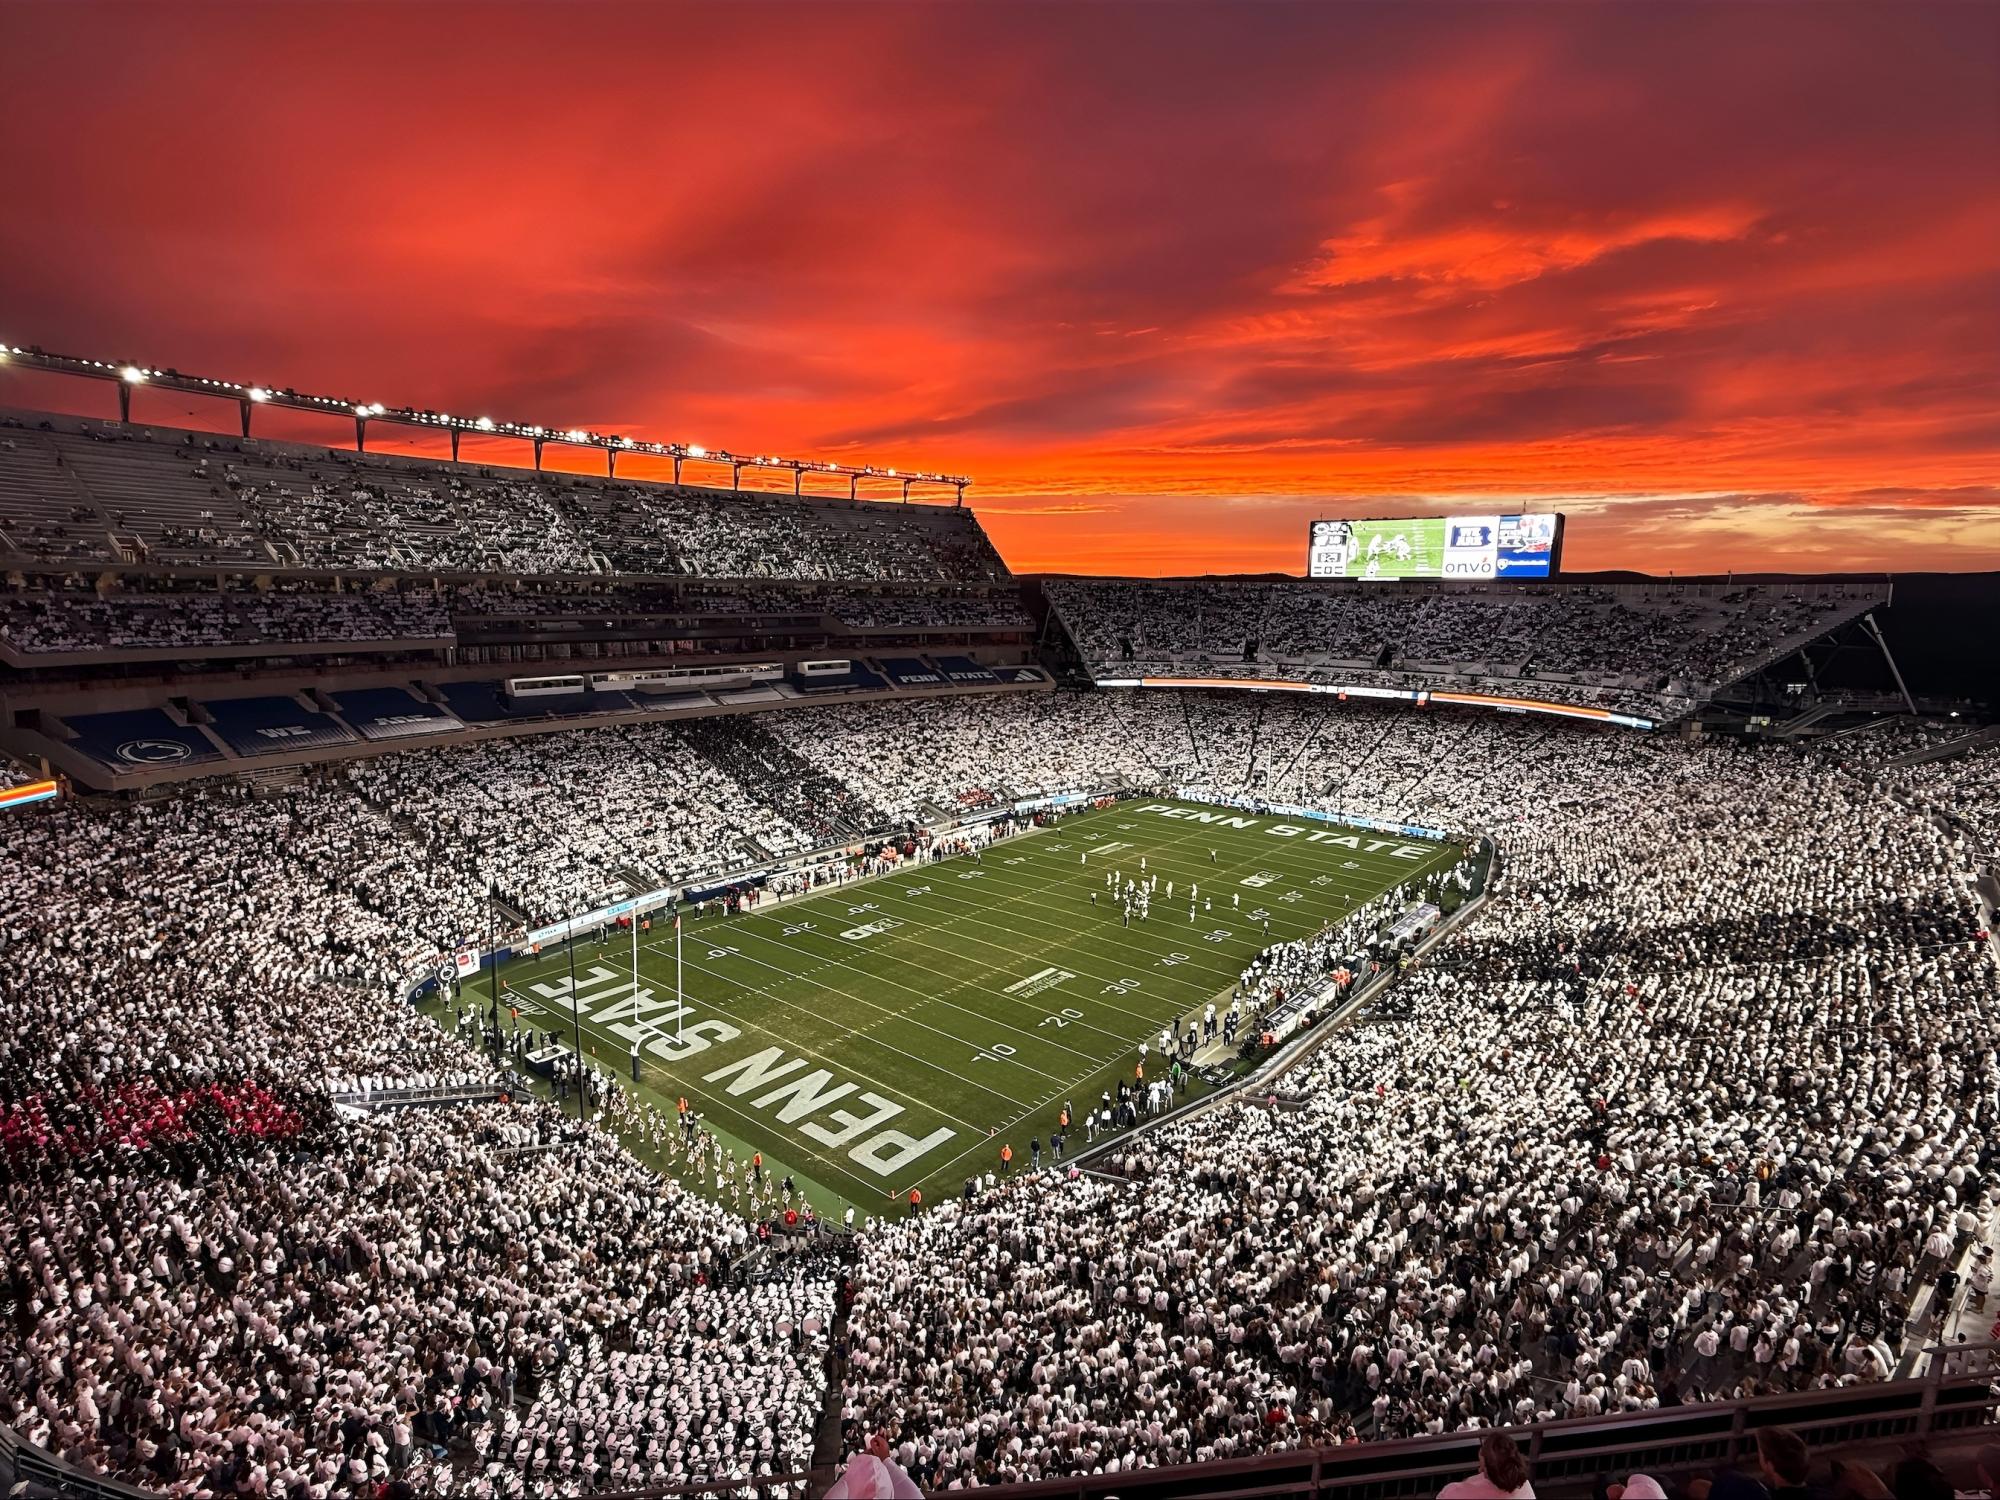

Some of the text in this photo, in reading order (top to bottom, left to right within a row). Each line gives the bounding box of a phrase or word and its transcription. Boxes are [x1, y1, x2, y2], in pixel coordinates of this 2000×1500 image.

[898, 671, 993, 683] PENN STATE
[256, 725, 312, 738] WE
[1134, 804, 1432, 860] PENN STATE
[1245, 908, 1270, 920] 40
[784, 921, 817, 935] 20
[1203, 929, 1232, 943] 50
[710, 946, 740, 959] 10
[1161, 952, 1190, 966] 40
[1105, 978, 1141, 995] 30
[1044, 1008, 1084, 1028] 20
[979, 1043, 1017, 1062] 10
[528, 966, 957, 1177] PENN STATE
